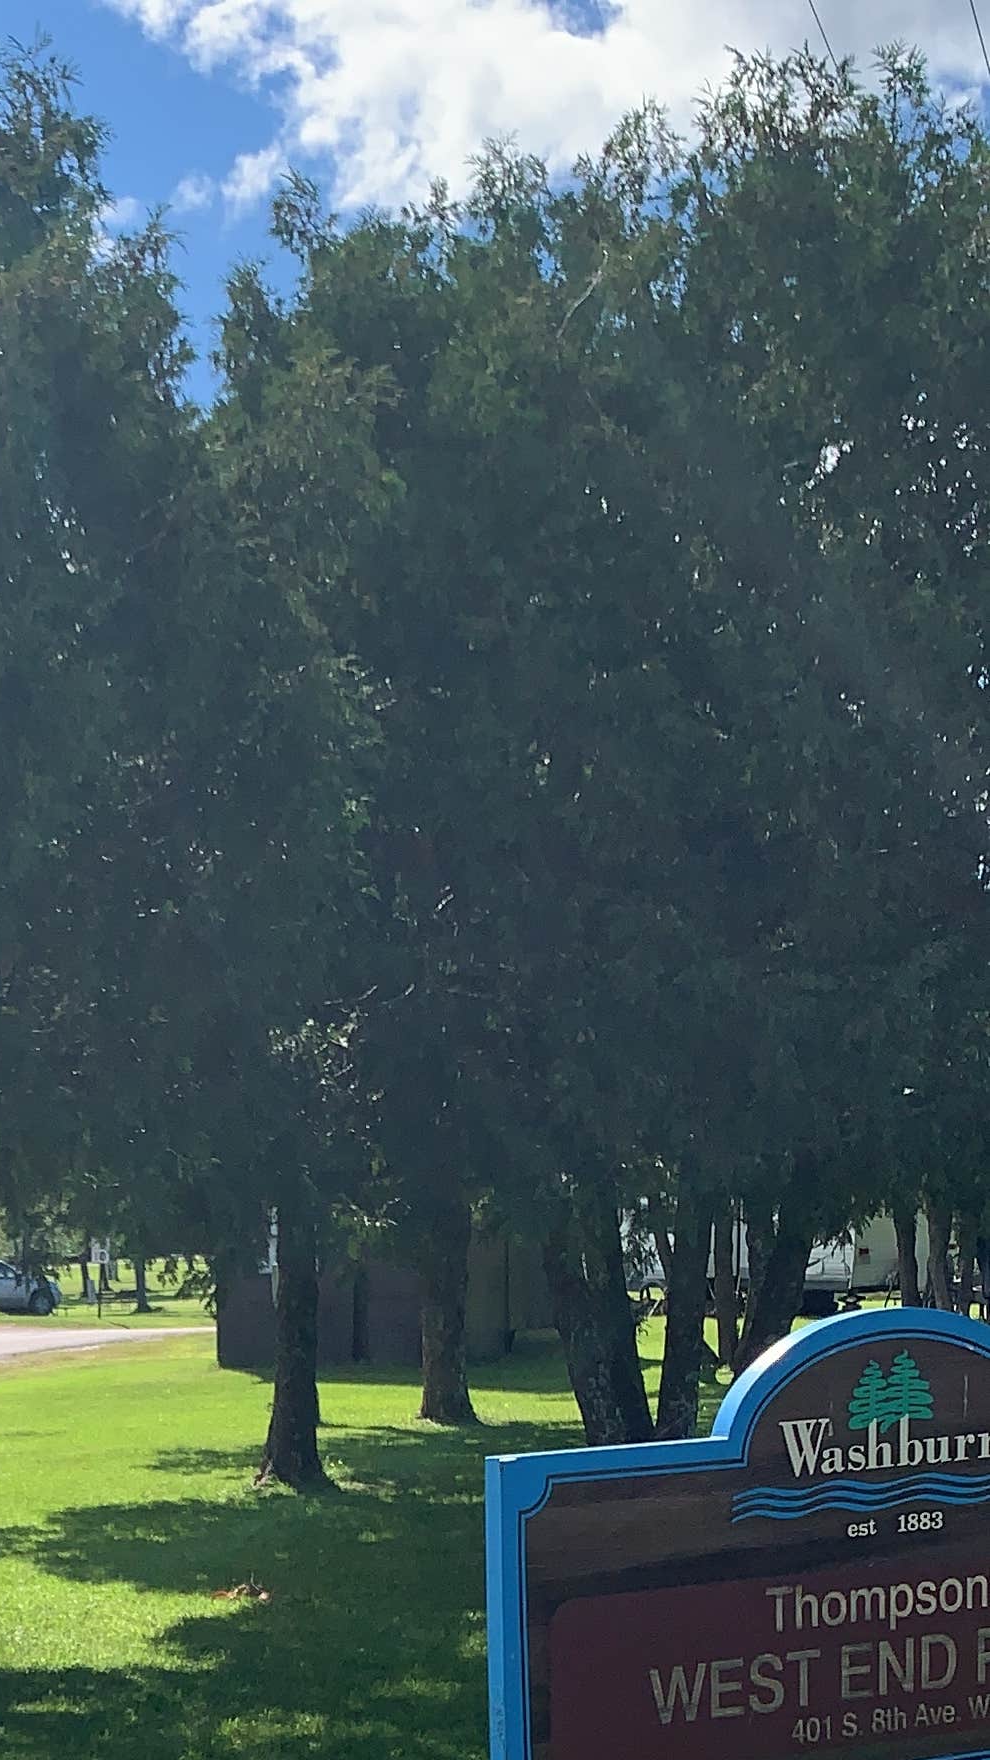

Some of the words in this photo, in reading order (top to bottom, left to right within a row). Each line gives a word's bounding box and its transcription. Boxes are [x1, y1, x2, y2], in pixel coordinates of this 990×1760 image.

[847, 1521, 877, 1537] est
[897, 1512, 944, 1533] 1883
[765, 1575, 989, 1632] Thompson
[649, 1649, 821, 1725] WEST
[841, 1634, 958, 1700] END
[791, 1716, 832, 1743] 401
[842, 1711, 863, 1738] S.
[871, 1704, 907, 1733] 8th
[914, 1702, 961, 1727] Ave.
